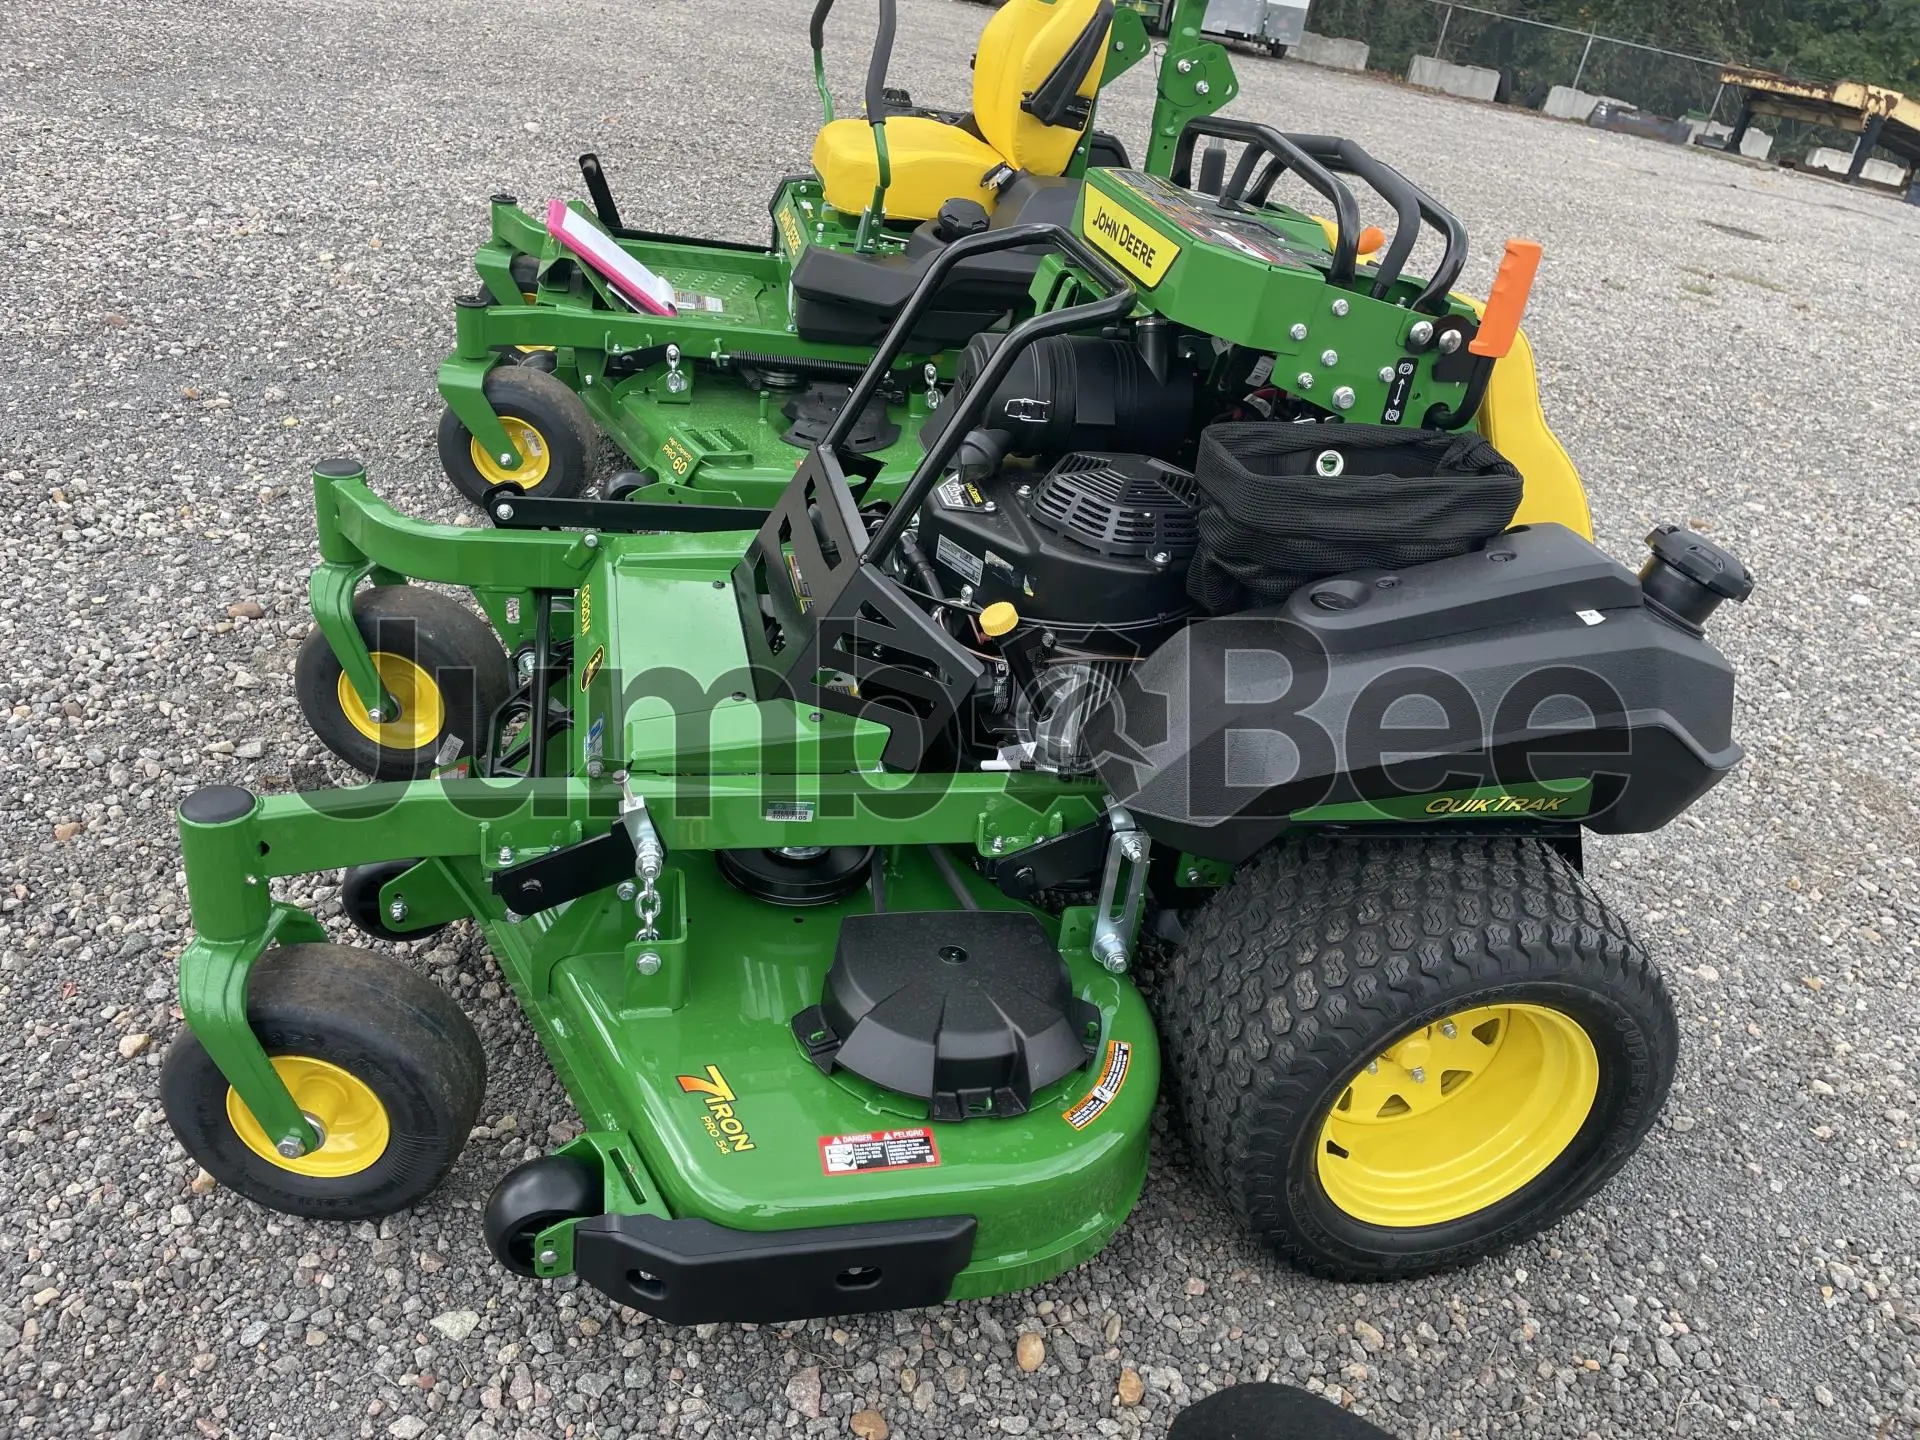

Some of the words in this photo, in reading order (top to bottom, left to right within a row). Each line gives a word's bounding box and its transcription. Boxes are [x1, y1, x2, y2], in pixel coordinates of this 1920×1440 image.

[1092, 206, 1121, 242] JOHN
[1119, 224, 1156, 269] DEERE
[662, 443, 677, 460] PRO
[672, 456, 688, 475] 60
[1613, 1017, 1649, 1093] SUPER
[700, 1115, 721, 1138] PRO
[714, 1139, 731, 1155] 54
[842, 1133, 873, 1143] DANGER
[893, 1129, 925, 1139] PELIGRO
